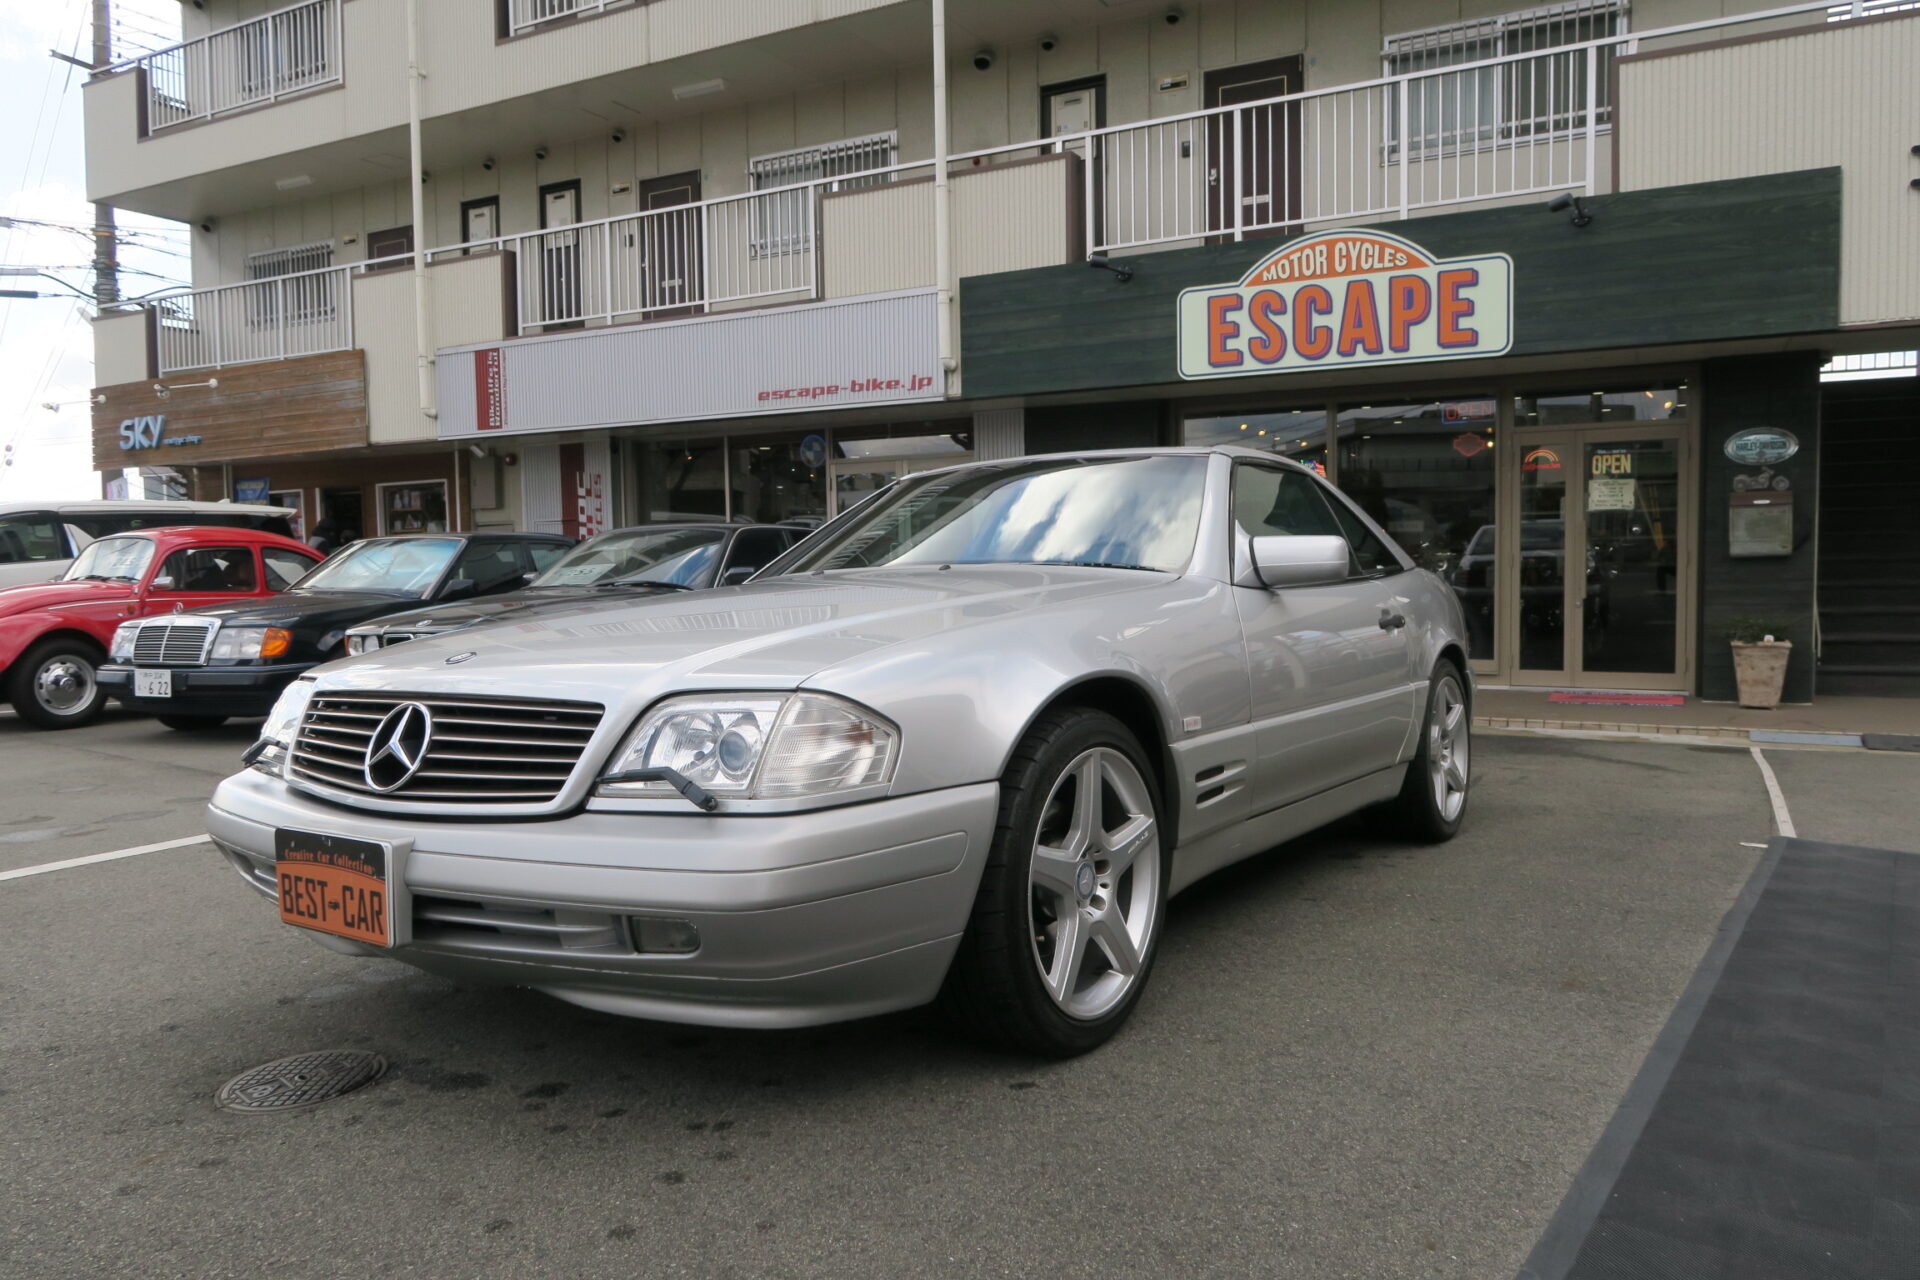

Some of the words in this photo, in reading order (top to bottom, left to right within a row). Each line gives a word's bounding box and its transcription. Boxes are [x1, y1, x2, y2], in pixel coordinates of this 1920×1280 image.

[1262, 244, 1328, 282] MOTOR
[1207, 268, 1479, 368] ESCAPE
[492, 351, 500, 426] Wonderful
[757, 374, 933, 401] escape-bike.jp
[1445, 402, 1492, 420] OPEN
[119, 414, 165, 449] SKY
[1592, 454, 1632, 475] OPEN
[317, 851, 331, 864] Car
